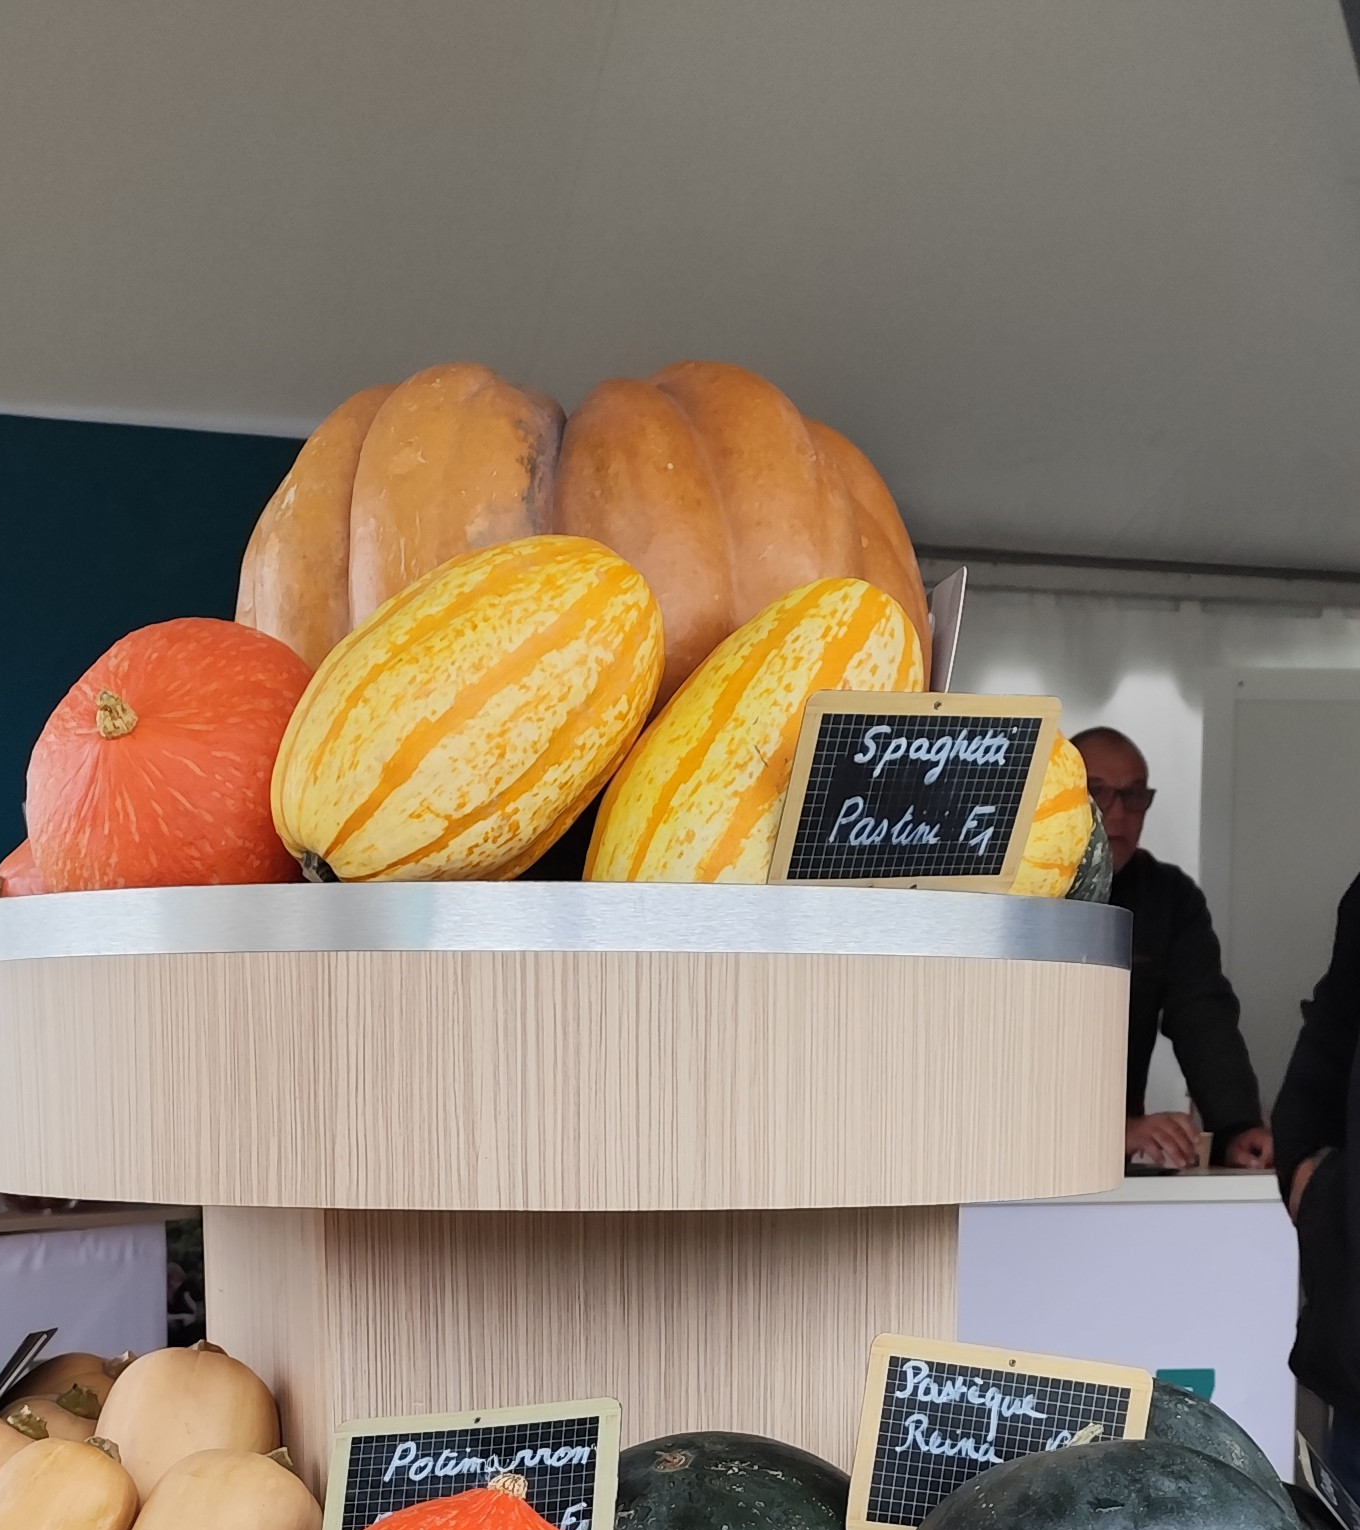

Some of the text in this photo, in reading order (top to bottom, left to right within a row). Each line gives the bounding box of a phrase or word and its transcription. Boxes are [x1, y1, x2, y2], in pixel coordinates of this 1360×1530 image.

[854, 725, 1018, 786] Spaghetti
[829, 796, 996, 857] Pastini F1
[383, 1441, 591, 1483] Potimarron
